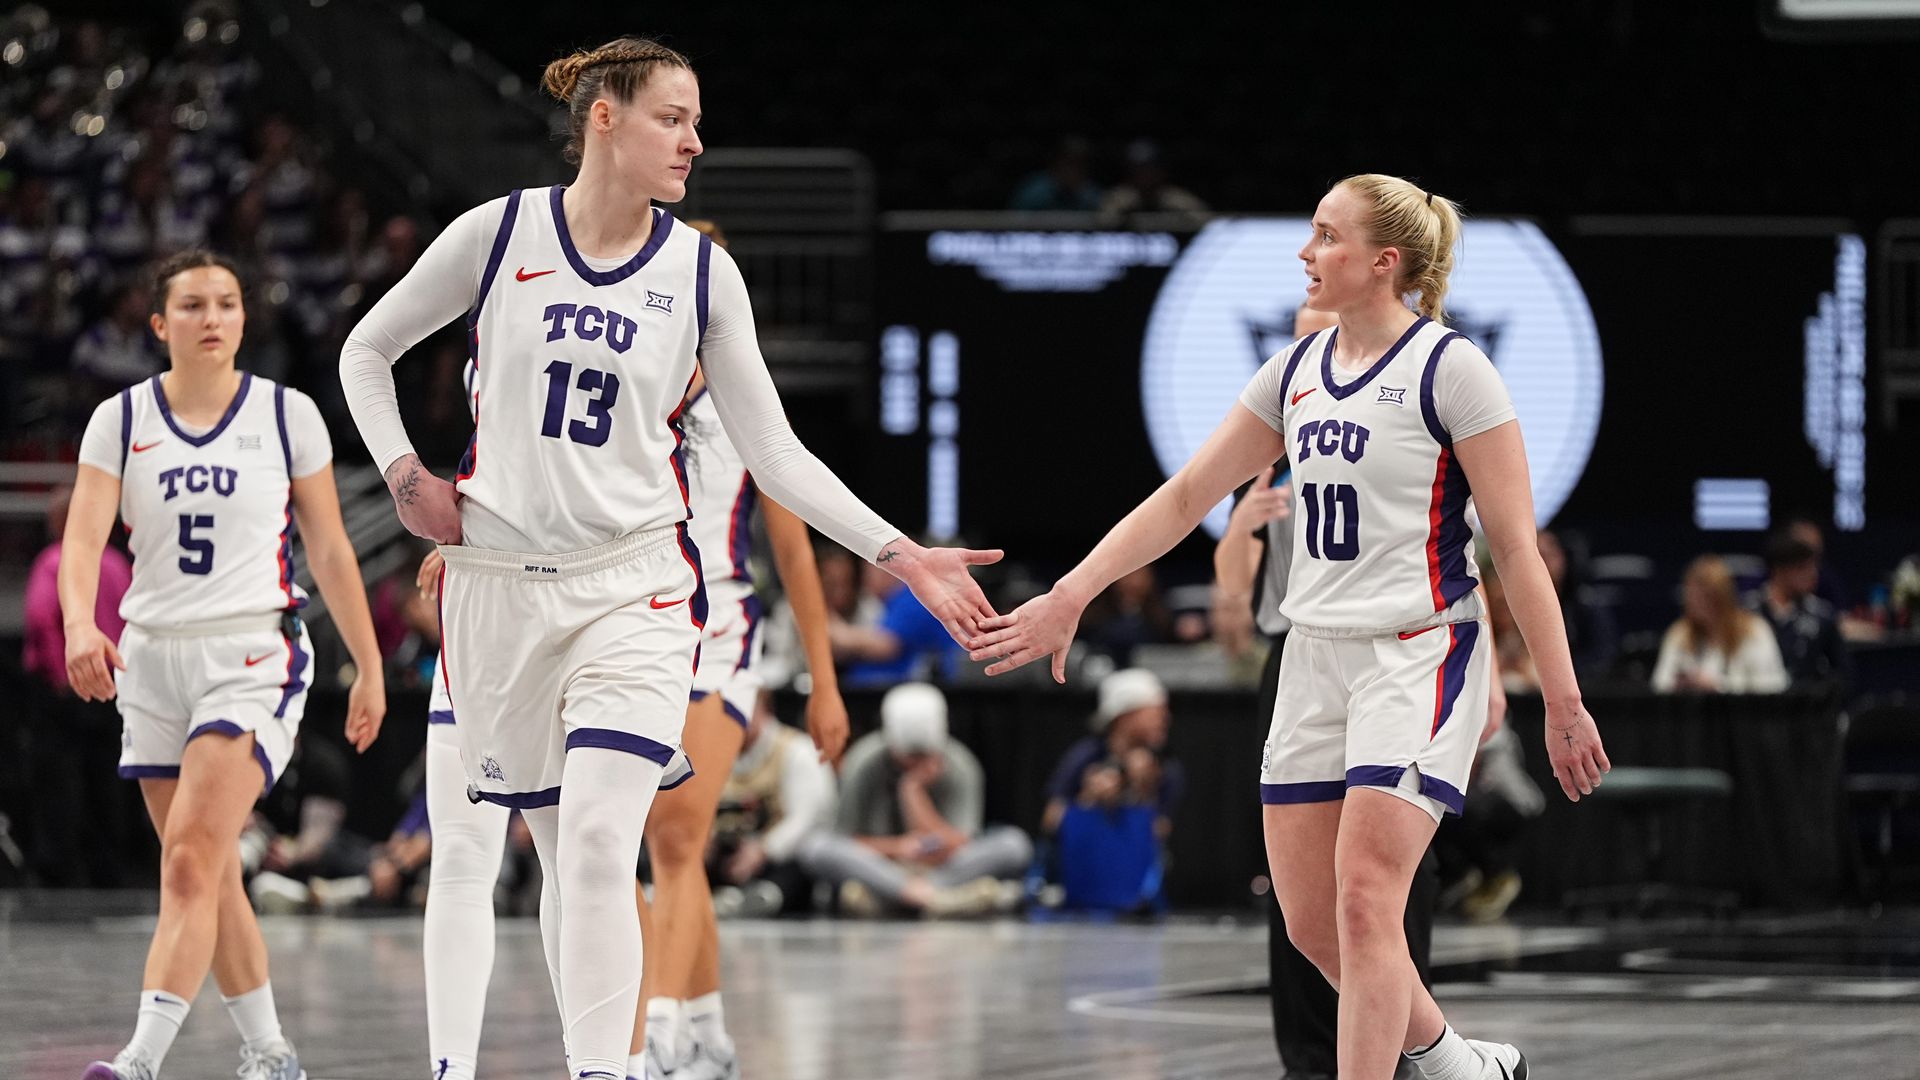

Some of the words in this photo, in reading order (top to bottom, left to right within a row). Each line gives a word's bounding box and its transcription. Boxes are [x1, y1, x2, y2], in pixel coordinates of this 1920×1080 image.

[543, 303, 638, 354] TCU
[541, 360, 620, 447] 13
[1297, 419, 1370, 464] TCU
[159, 465, 238, 501] TCU
[178, 514, 214, 575] 5
[1301, 482, 1360, 561] 10
[524, 565, 539, 573] RIFF
